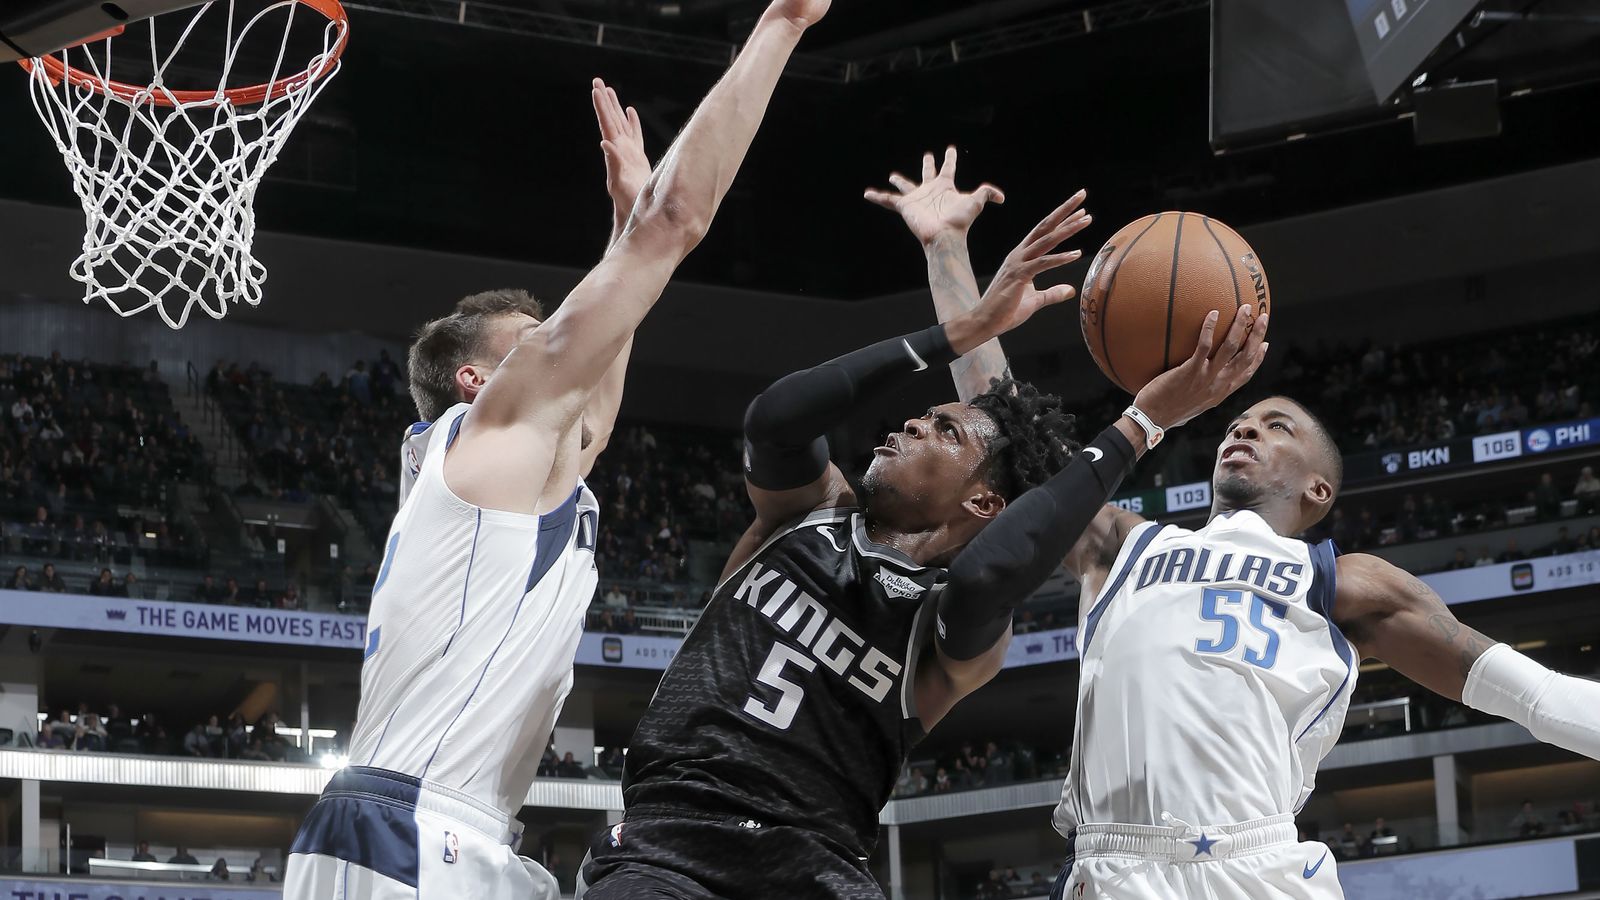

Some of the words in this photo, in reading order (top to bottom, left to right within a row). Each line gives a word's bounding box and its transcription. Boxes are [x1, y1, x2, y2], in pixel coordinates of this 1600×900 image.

[1554, 424, 1590, 446] PHI
[1408, 447, 1450, 469] BKN
[1175, 489, 1204, 506] 103
[1134, 546, 1304, 597] DALLAS
[137, 607, 177, 628] THE
[183, 610, 240, 633] GAME
[246, 616, 313, 638] MOVES
[733, 562, 903, 704] KINGS
[1193, 586, 1289, 671] 55
[1052, 634, 1076, 653] TH
[743, 640, 818, 730] 5
